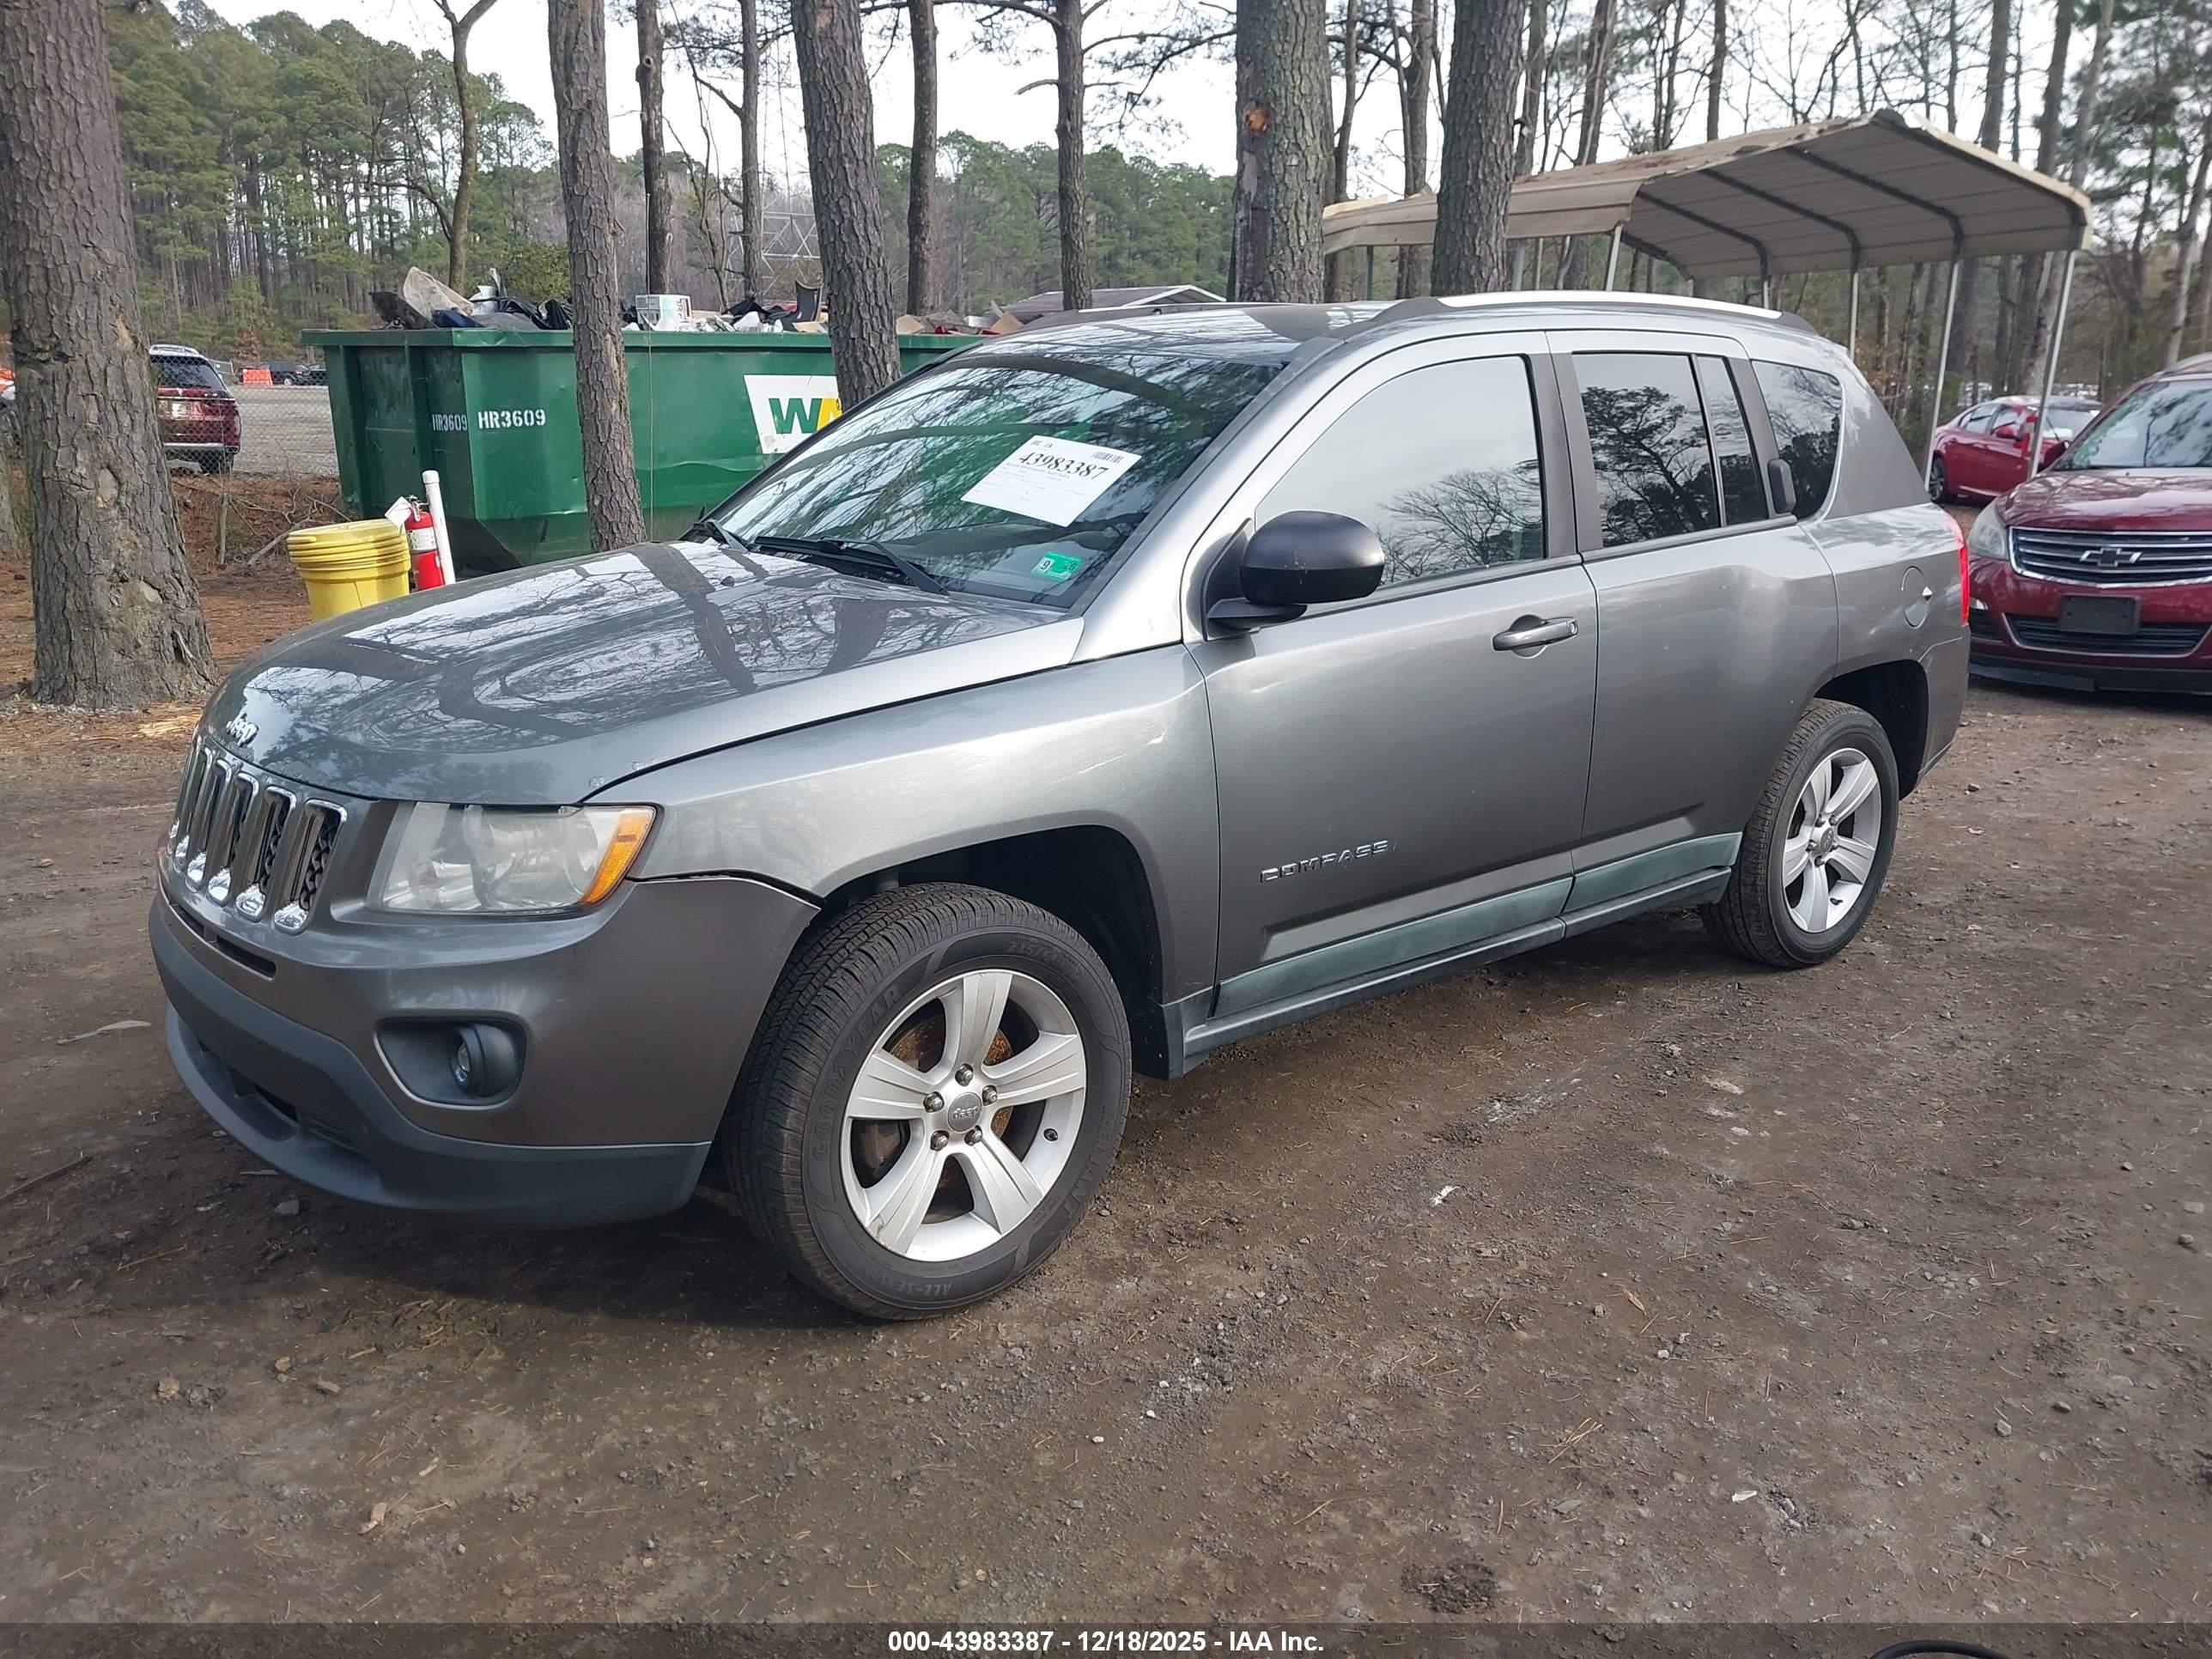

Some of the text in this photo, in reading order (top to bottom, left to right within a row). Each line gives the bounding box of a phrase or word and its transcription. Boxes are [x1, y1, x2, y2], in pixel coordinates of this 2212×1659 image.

[431, 413, 468, 431] HR3609
[477, 408, 547, 429] HR3609
[1018, 451, 1109, 480] 43983387
[1259, 839, 1389, 884] COMPASS
[812, 987, 901, 1161] GOODYEAR
